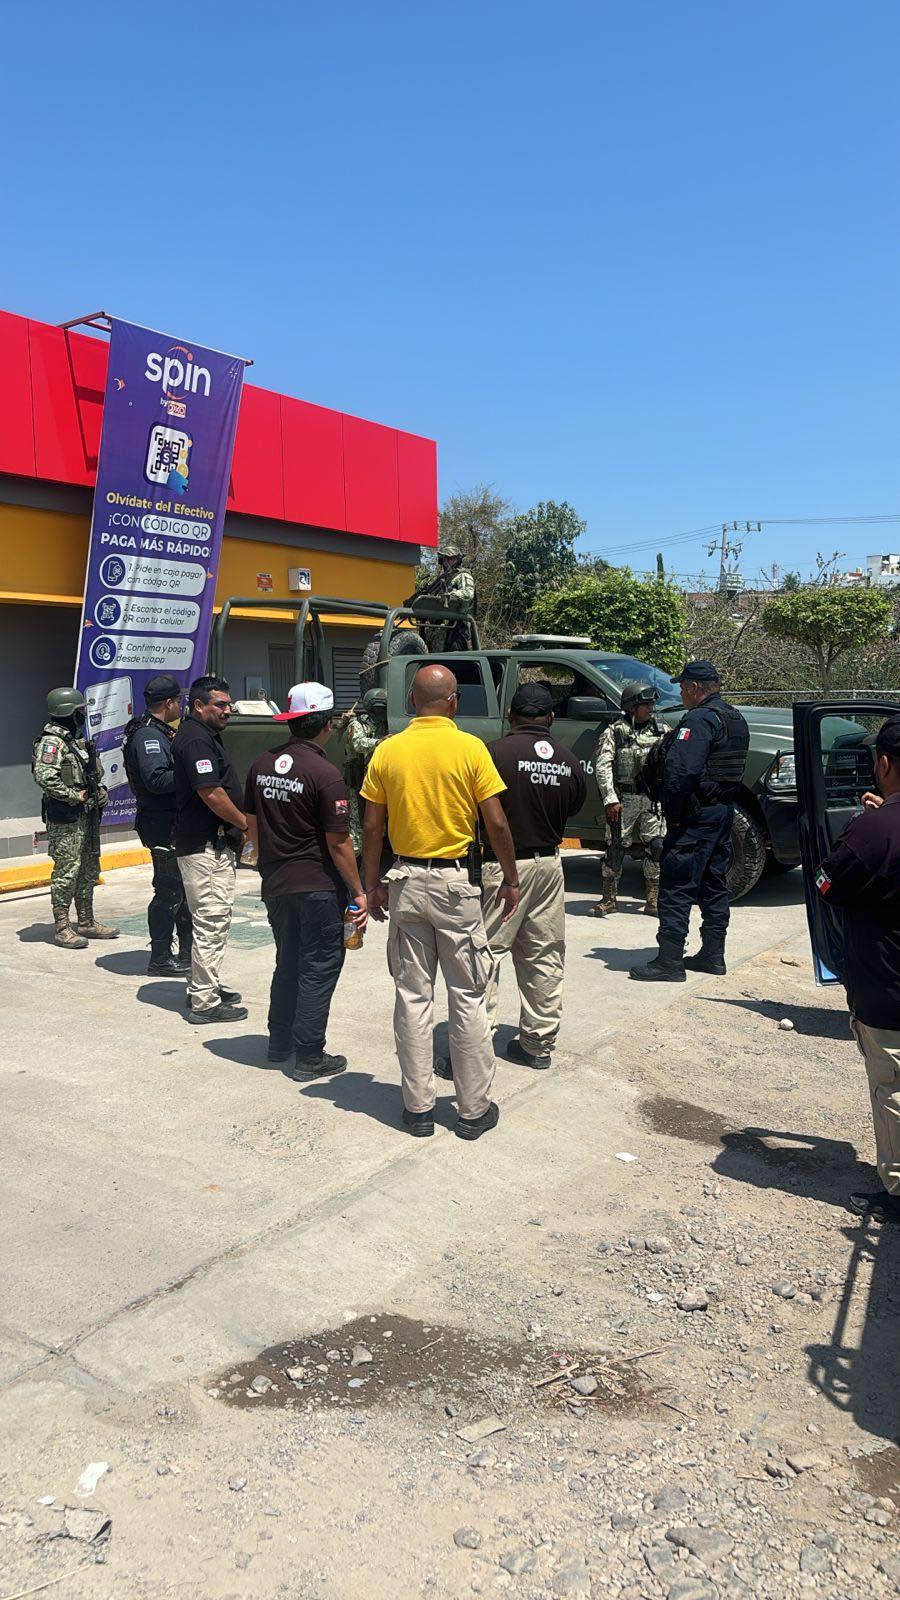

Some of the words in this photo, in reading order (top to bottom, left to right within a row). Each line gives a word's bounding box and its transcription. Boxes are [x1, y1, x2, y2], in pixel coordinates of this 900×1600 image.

[145, 352, 212, 396] spin
[160, 397, 168, 406] by
[106, 492, 152, 510] Olvídate
[156, 500, 171, 512] del
[174, 504, 214, 520] Efectivo
[108, 512, 140, 528] ¡CON
[144, 517, 190, 534] CÓDIGO
[192, 525, 208, 538] QR
[101, 532, 136, 548] PAGA
[140, 537, 164, 551] MÁS
[135, 564, 152, 574] Pide
[163, 567, 179, 578] caja
[181, 570, 202, 580] pagar
[142, 576, 168, 588] código
[169, 580, 180, 588] QR
[131, 604, 163, 614] Escanea
[172, 607, 196, 618] código
[123, 614, 134, 623] QR
[160, 616, 184, 625] celular
[126, 643, 161, 653] Confirma
[168, 646, 186, 654] paga
[116, 655, 140, 663] desde
[518, 760, 572, 777] PROTECCIÓN
[256, 775, 304, 794] PROTECCIÓN
[530, 773, 560, 786] CIVIL
[263, 787, 291, 802] CIVIL
